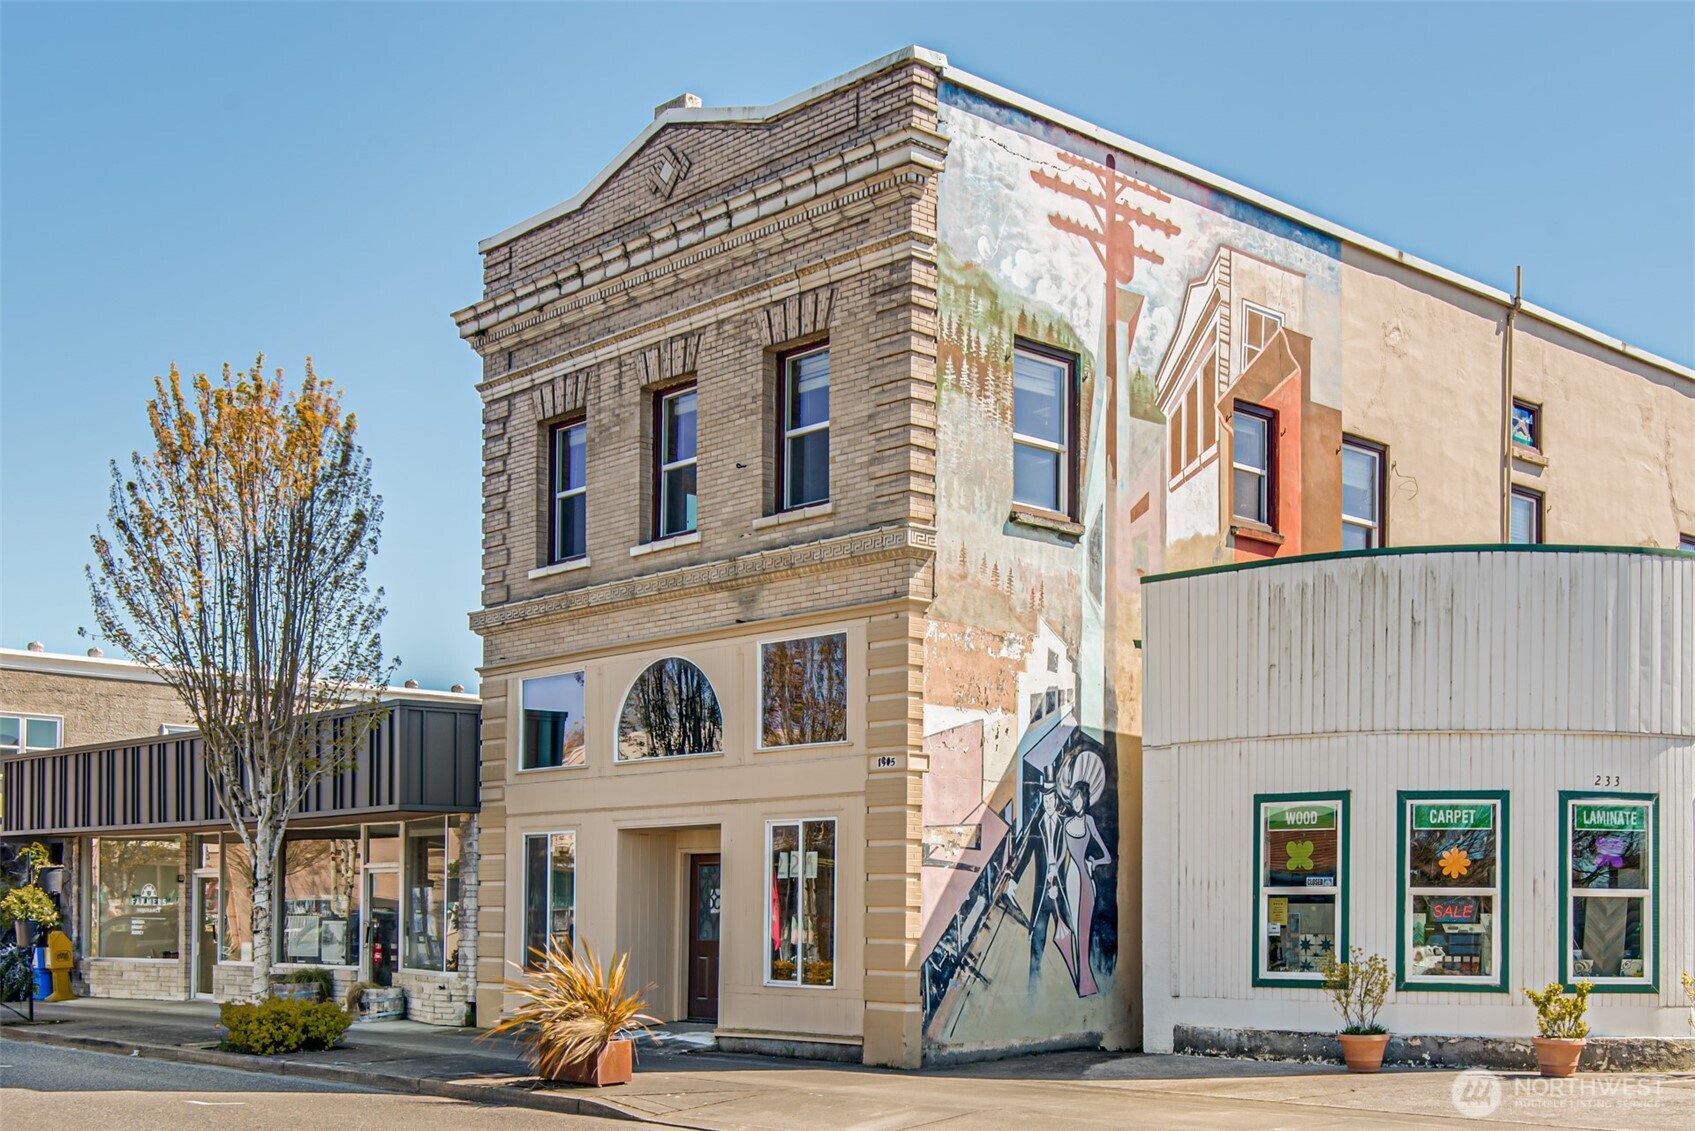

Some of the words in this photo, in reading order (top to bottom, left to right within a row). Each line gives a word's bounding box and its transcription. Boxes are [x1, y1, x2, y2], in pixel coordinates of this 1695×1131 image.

[877, 756, 896, 767] 1905
[1594, 775, 1621, 787] 233
[1285, 810, 1318, 825] WOOD
[1429, 809, 1476, 824] CARPET
[1582, 810, 1638, 825] LAMINATE
[131, 898, 167, 906] FARMERS
[1433, 904, 1474, 918] SALE
